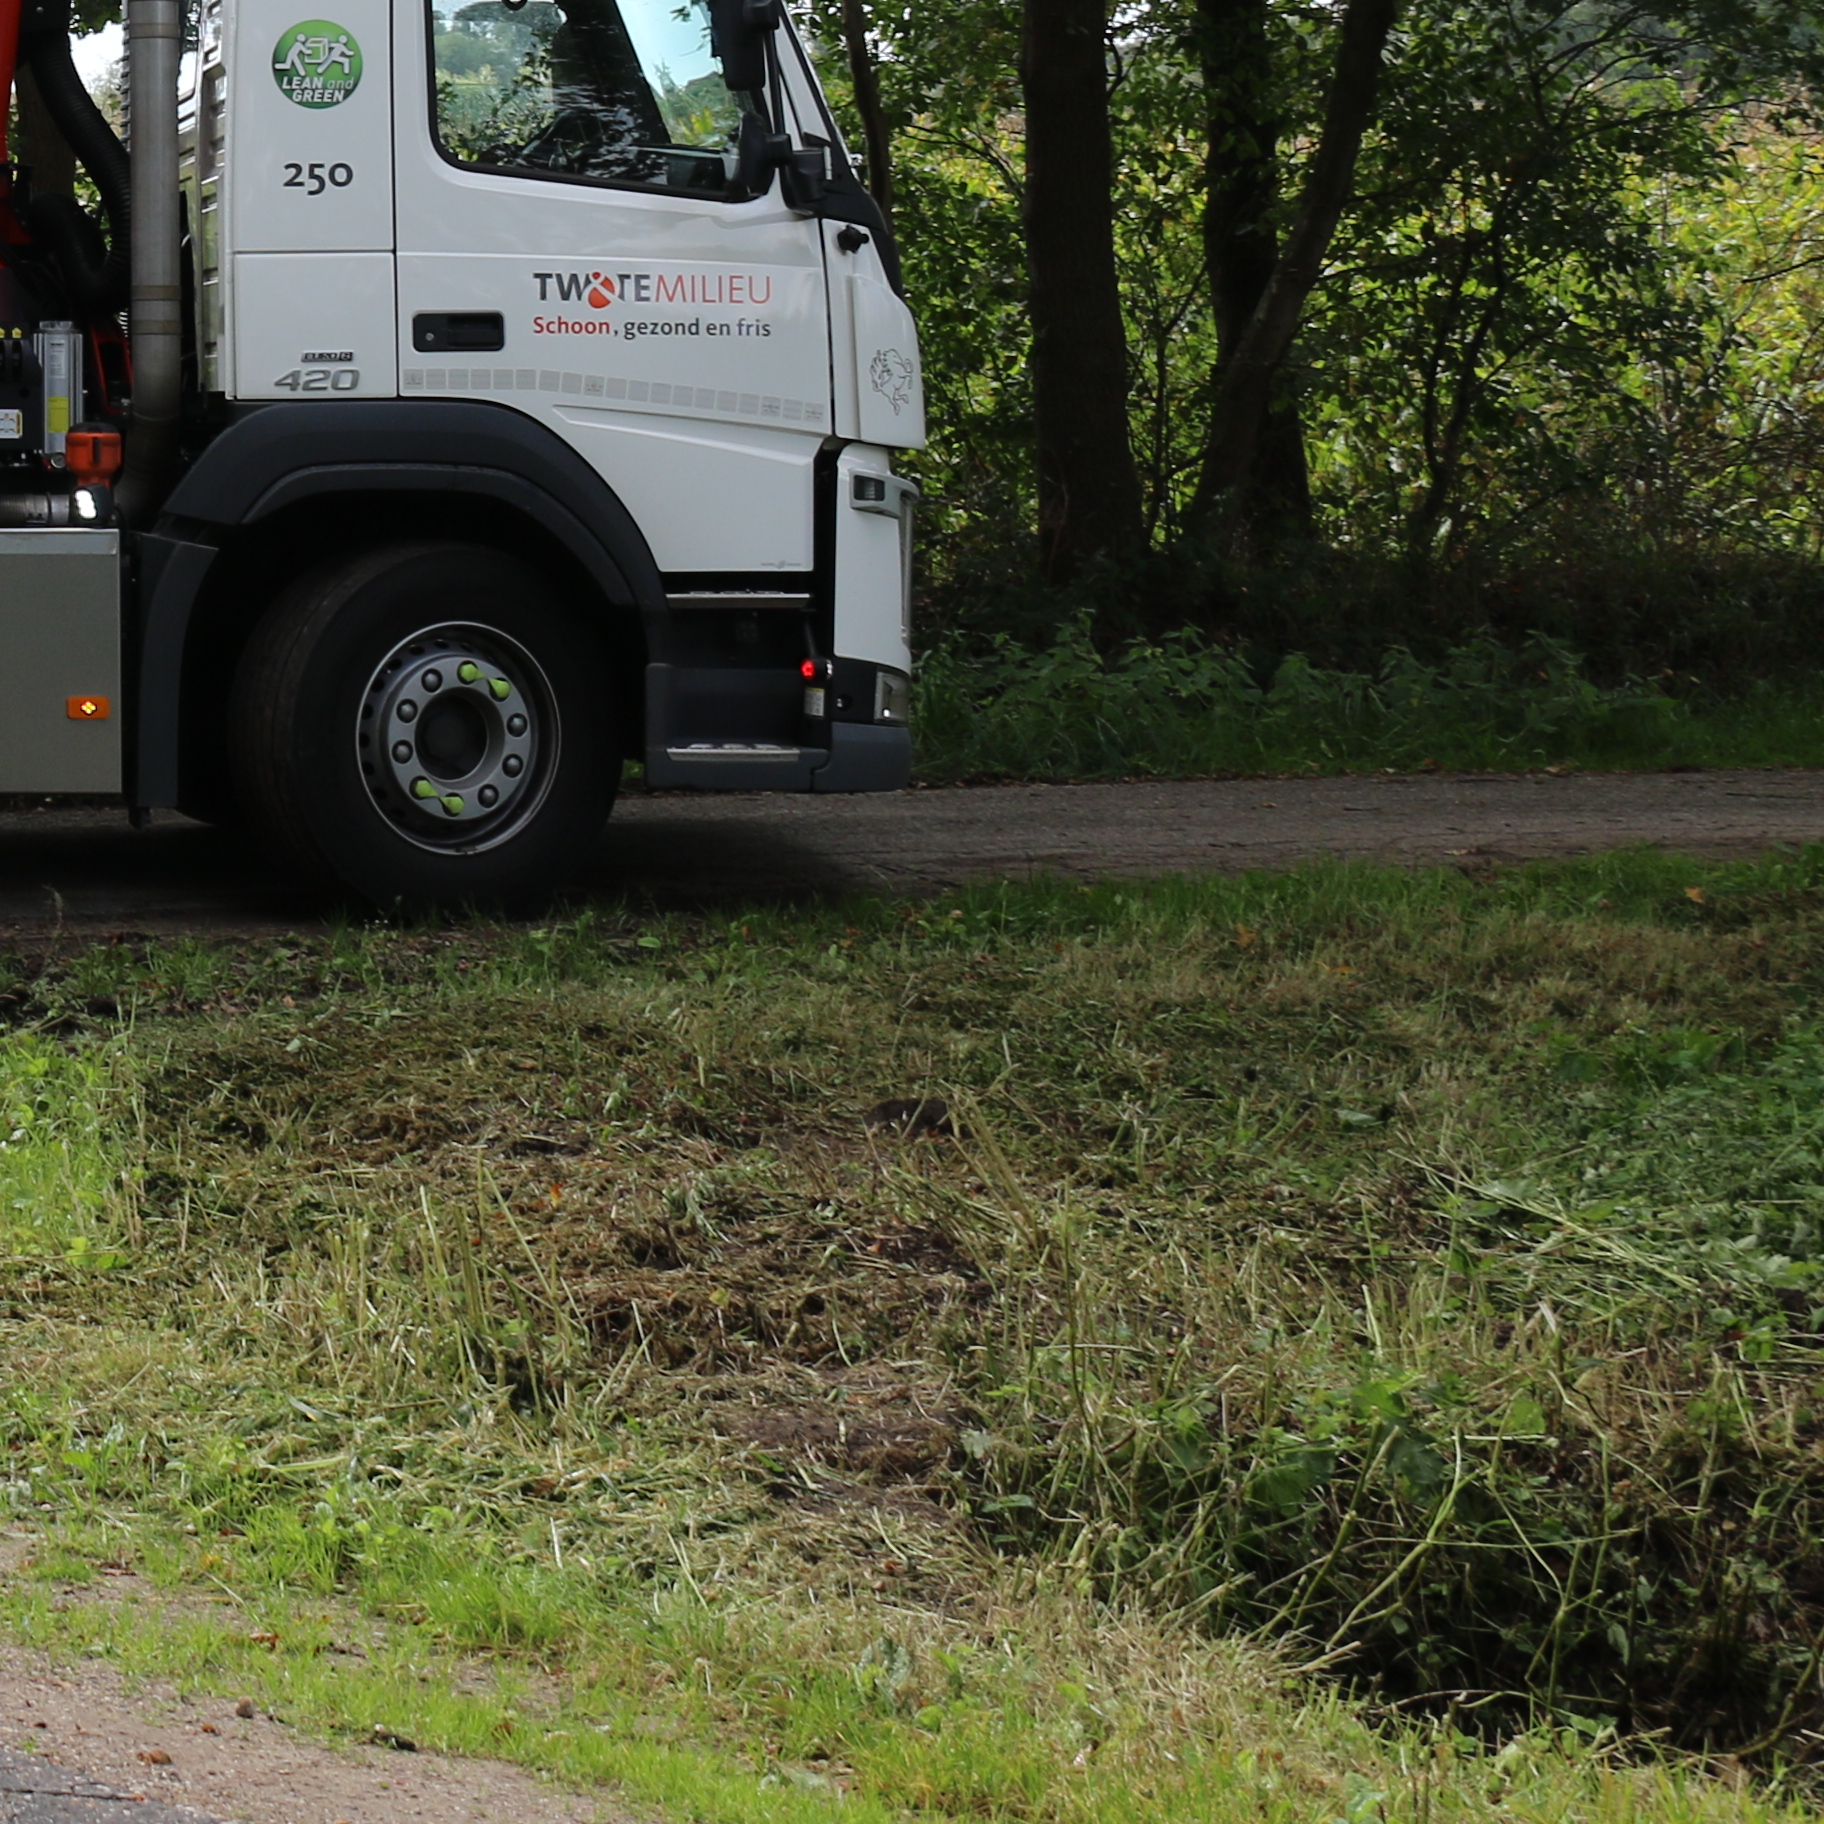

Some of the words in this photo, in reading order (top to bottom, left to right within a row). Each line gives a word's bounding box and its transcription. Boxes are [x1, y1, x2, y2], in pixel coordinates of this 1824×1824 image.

[282, 76, 323, 90] LEAN
[327, 76, 354, 90] and
[292, 89, 345, 102] GREEN
[282, 162, 354, 196] 250
[533, 315, 619, 337] Schoon,
[623, 317, 700, 341] gezond
[705, 322, 731, 337] en
[736, 317, 772, 338] fris
[274, 368, 360, 391] 420
